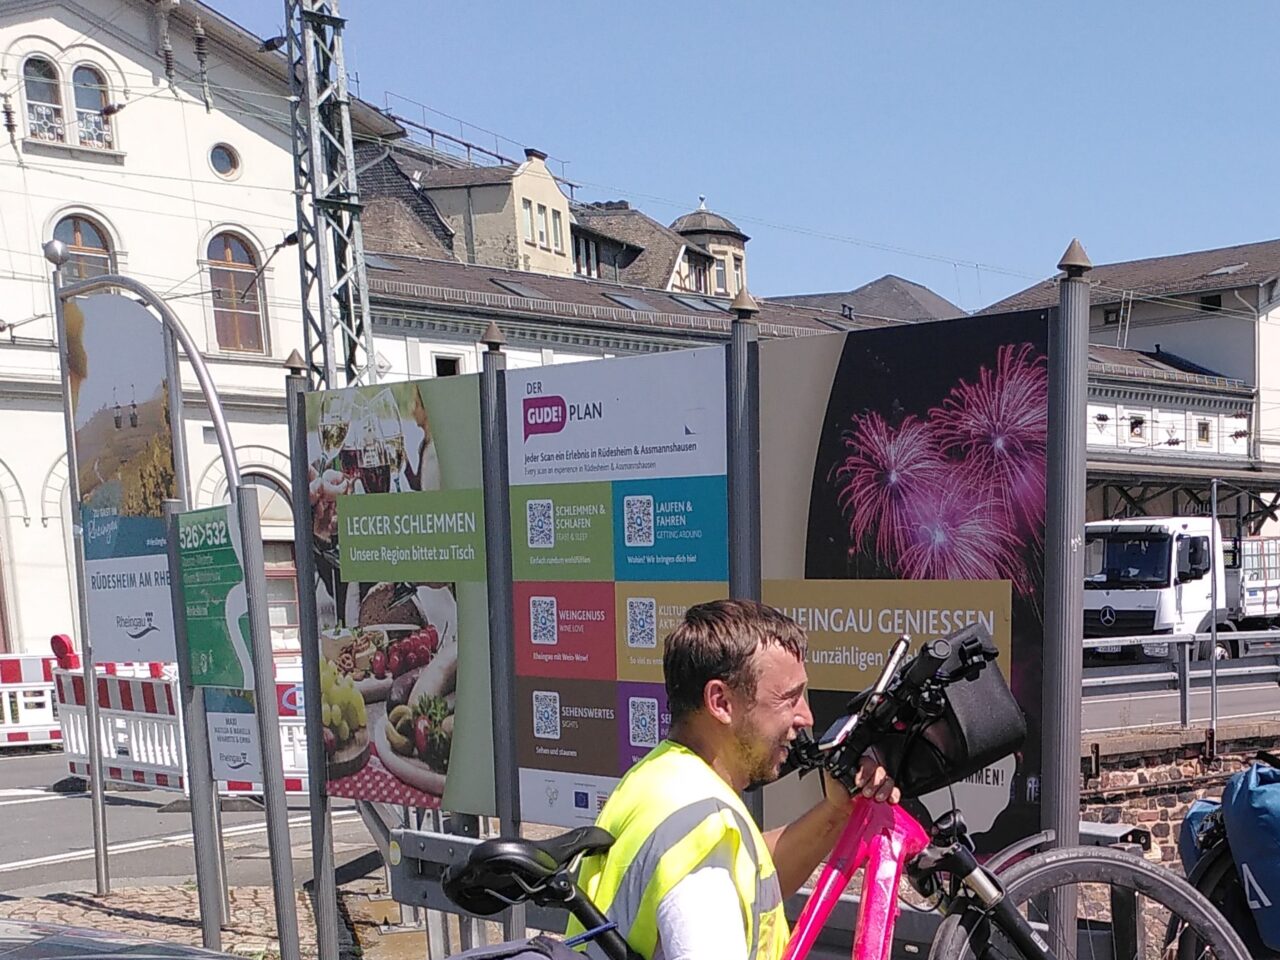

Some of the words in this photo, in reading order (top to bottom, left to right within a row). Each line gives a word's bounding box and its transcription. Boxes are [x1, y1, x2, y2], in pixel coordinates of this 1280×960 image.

[527, 381, 542, 394] DER
[527, 406, 562, 424] GUDE!
[569, 402, 602, 421] PLAN
[524, 453, 539, 464] Jeder
[540, 451, 554, 462] Scan
[556, 451, 564, 460] ein
[566, 448, 589, 460] Erlebnis
[591, 448, 596, 458] in
[598, 446, 632, 457] Rüdesheim
[634, 446, 639, 455] &
[641, 442, 697, 454] Assmannshausen
[556, 505, 598, 516] SCHLEMMEN
[599, 504, 606, 514] &
[656, 502, 684, 513] LAUFEN
[686, 501, 693, 512] &
[347, 515, 391, 536] LECKER
[394, 512, 476, 535] SCHLEMMEN
[556, 518, 591, 529] SCHLAFEN
[656, 515, 686, 526] FAHREN
[350, 547, 379, 561] Unsere
[381, 546, 411, 565] Region
[412, 545, 438, 560] bittet
[439, 549, 449, 560] zu
[450, 544, 475, 560] Tisch
[91, 571, 136, 590] RÜDESHEIM
[139, 571, 151, 587] AM
[116, 615, 146, 629] Rheingau
[559, 610, 605, 621] WEINGENUSS
[775, 608, 872, 632] HEINGAU
[878, 609, 994, 635] GENIESSEN
[812, 645, 883, 671] unzähligen
[561, 706, 614, 719] SEHENSWERTES
